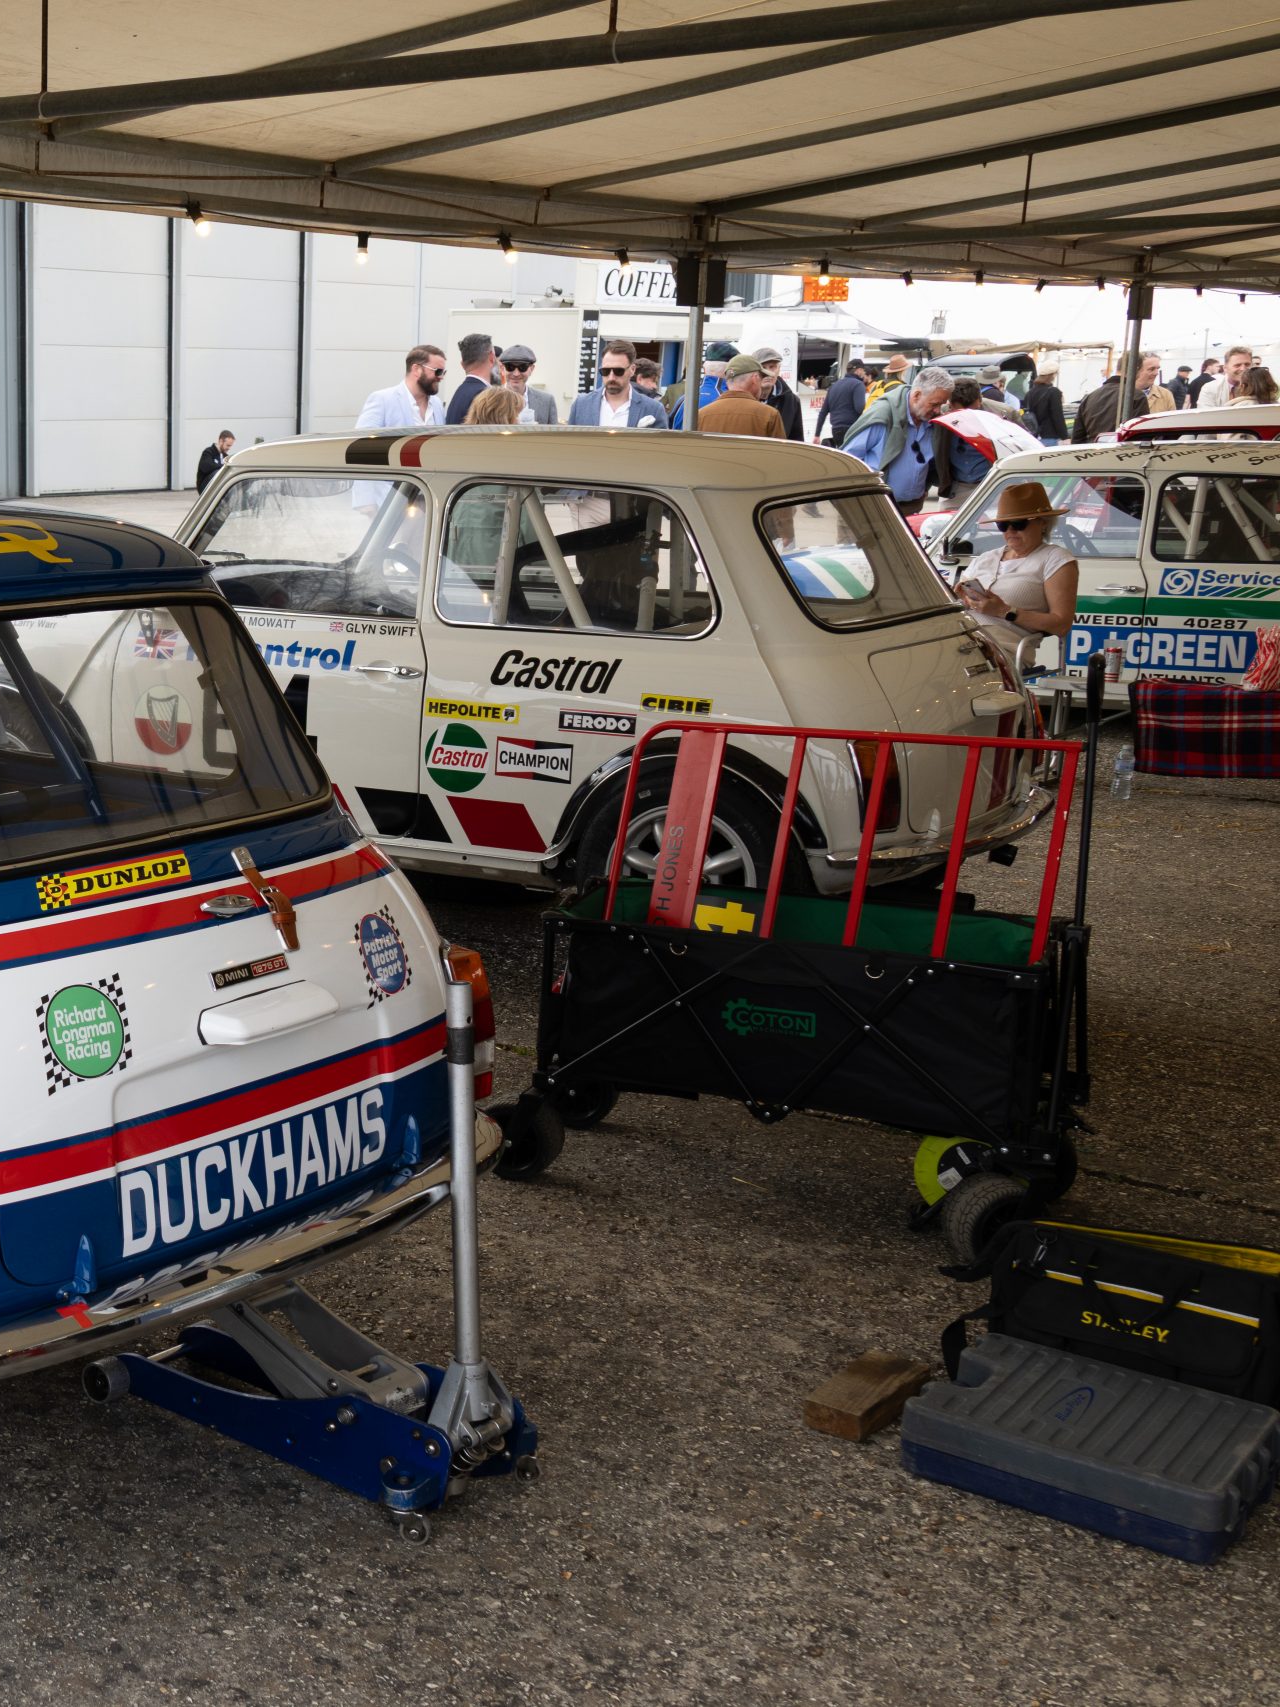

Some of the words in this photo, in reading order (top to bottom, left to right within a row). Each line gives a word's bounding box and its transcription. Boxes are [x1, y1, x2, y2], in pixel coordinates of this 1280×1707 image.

[605, 268, 677, 299] COFFE
[248, 617, 297, 629] MOWATT
[345, 623, 377, 635] GLYN
[379, 625, 416, 637] SWIFT
[1073, 614, 1158, 627] WEEDON
[1184, 617, 1248, 630] 40287
[1126, 632, 1248, 669] GREEN
[490, 649, 623, 694] Castrol
[427, 700, 501, 721] HEPOLITE
[562, 714, 632, 732] FERODO
[431, 745, 489, 769] Castrol
[499, 750, 570, 772] CHAMPION
[661, 825, 684, 892] JONES
[73, 858, 187, 894] DUNLOP
[363, 932, 396, 956] Patrick
[371, 947, 398, 968] Motor
[224, 968, 249, 982] MINI
[273, 958, 286, 967] GT
[375, 960, 402, 981] Sport
[53, 1000, 107, 1028] Richard
[52, 1020, 115, 1045] Longman
[65, 1038, 112, 1061] Racing
[120, 1087, 387, 1258] DUCKHAMS
